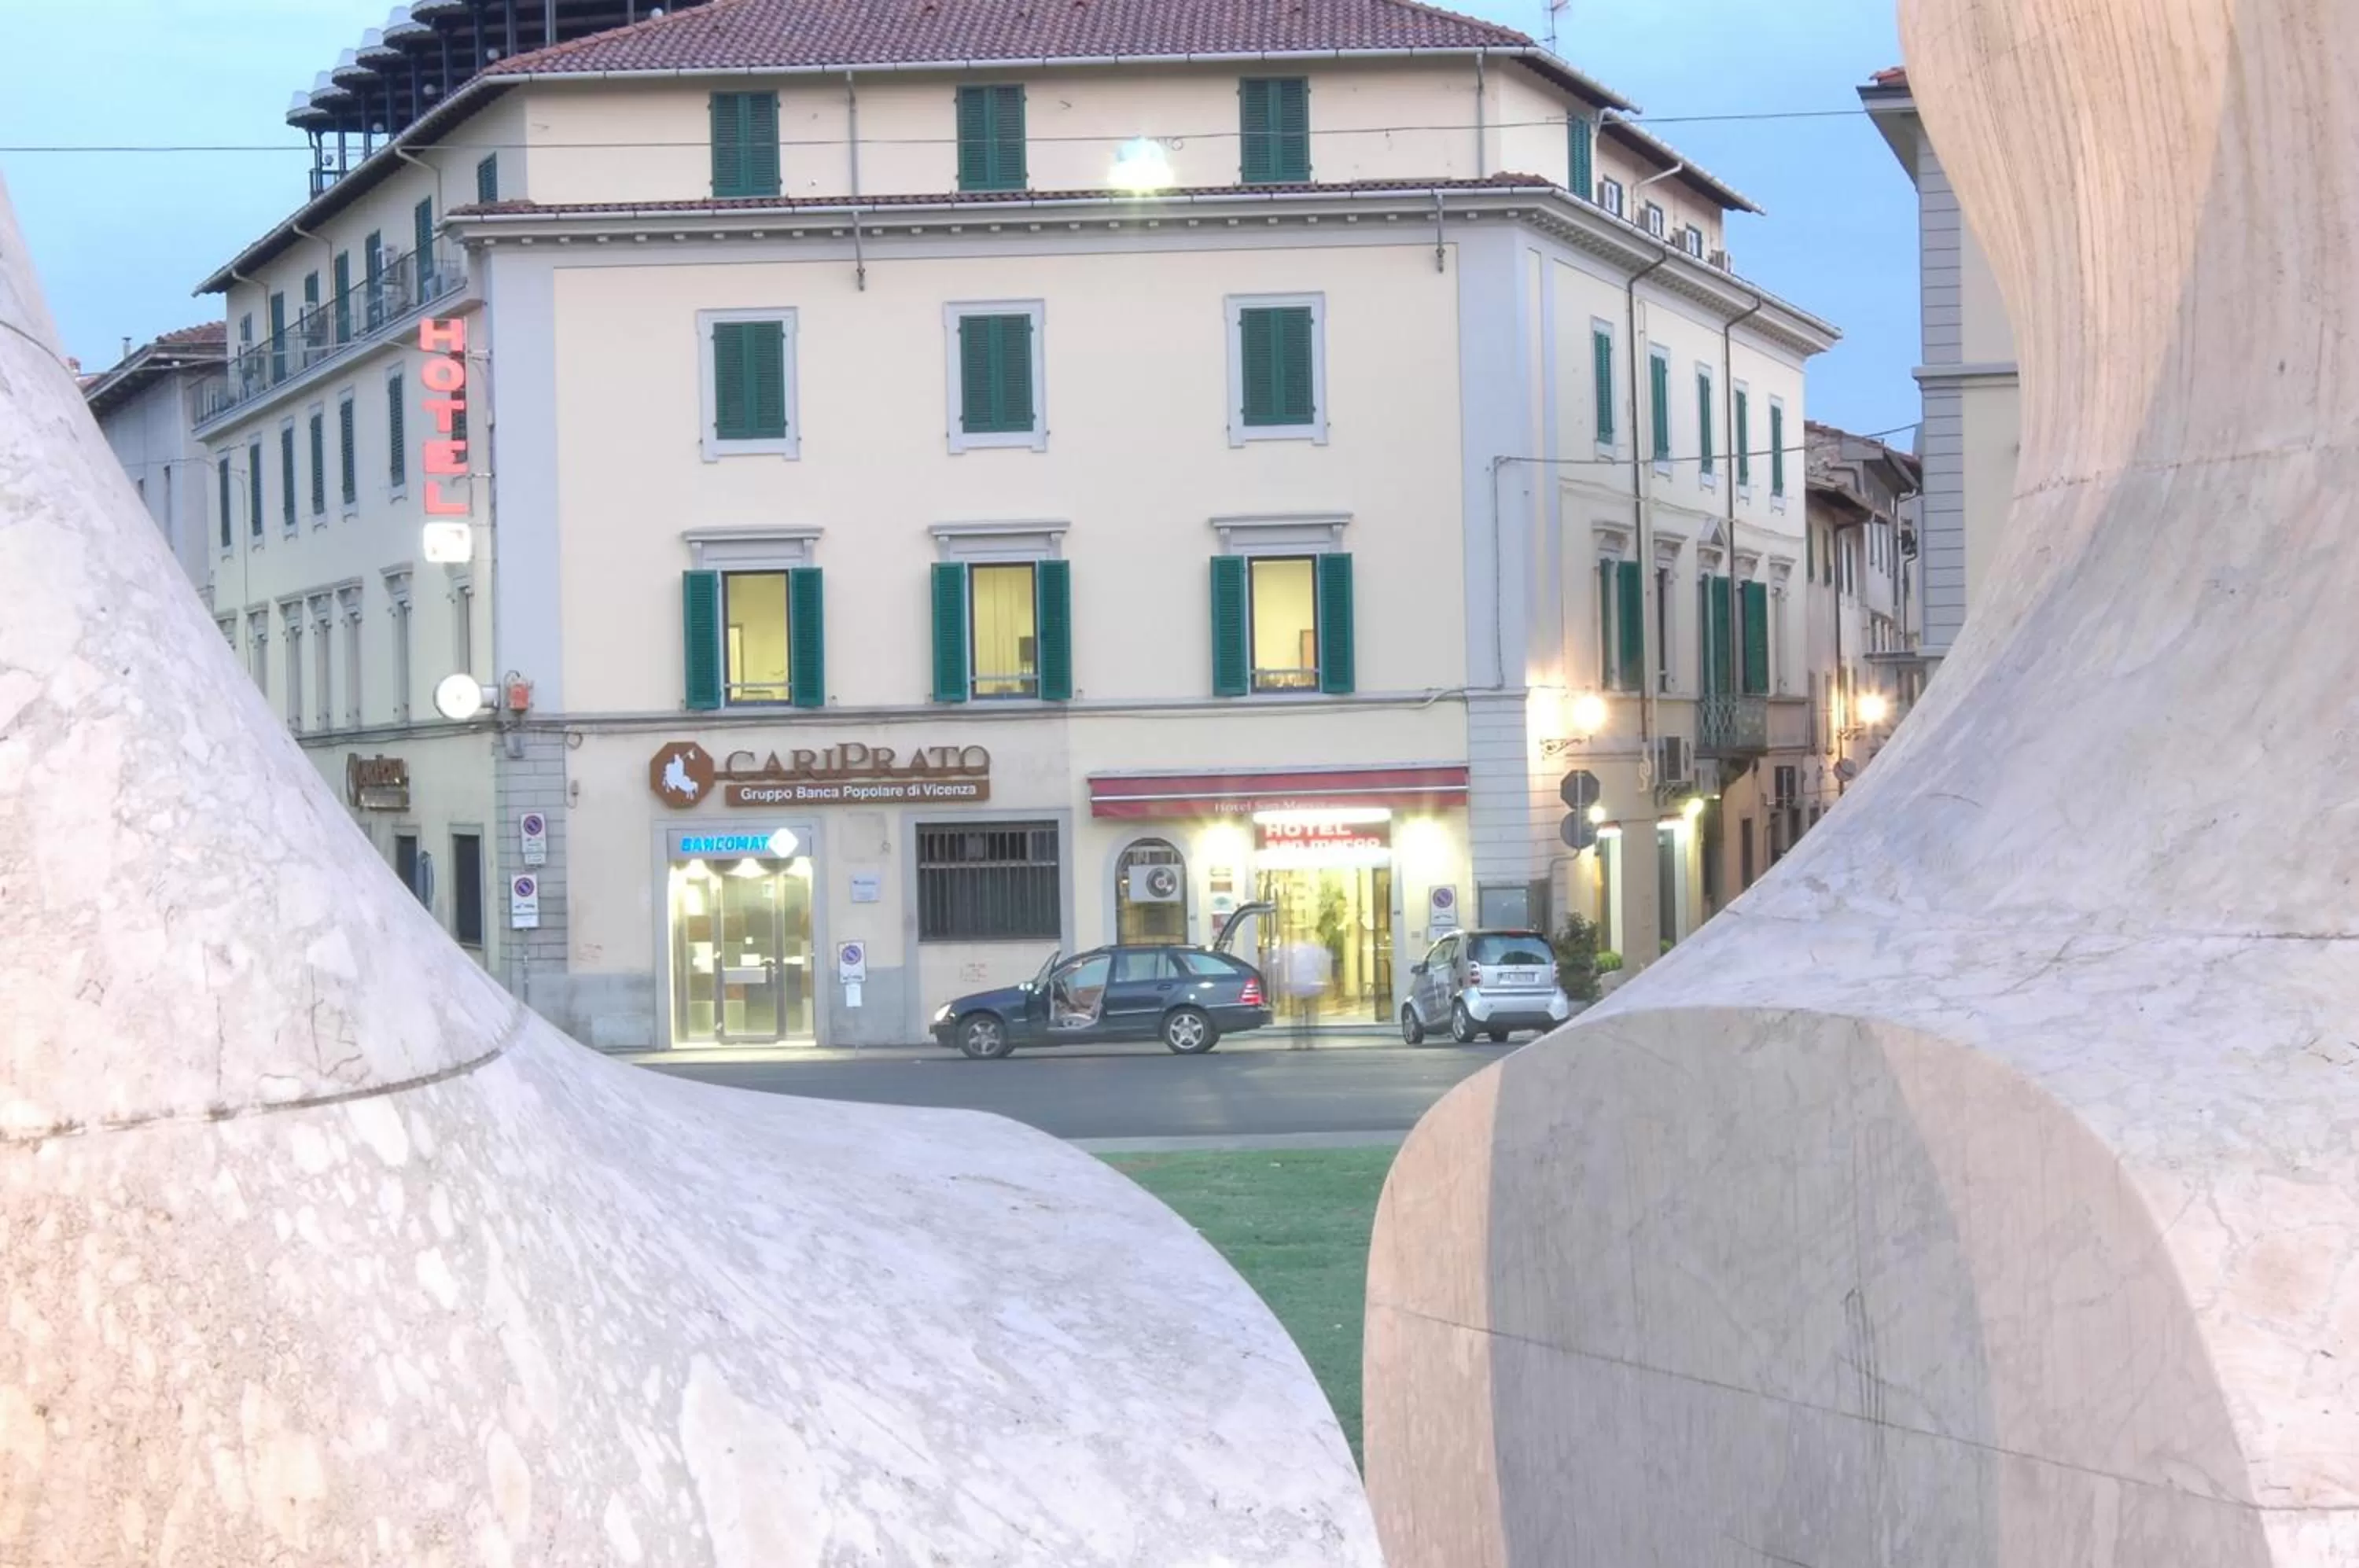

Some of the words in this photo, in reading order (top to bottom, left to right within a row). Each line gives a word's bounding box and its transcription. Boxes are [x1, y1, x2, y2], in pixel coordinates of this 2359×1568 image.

[419, 318, 469, 514] HOTEL
[725, 742, 991, 780] CARIPRATO
[741, 787, 792, 802] Gruppo
[797, 786, 839, 799] Banca
[843, 785, 903, 801] Popolare
[907, 785, 920, 797] di
[924, 784, 976, 796] Vicenza
[1264, 822, 1351, 837] HOTEL
[680, 834, 769, 852] BANCOMAT
